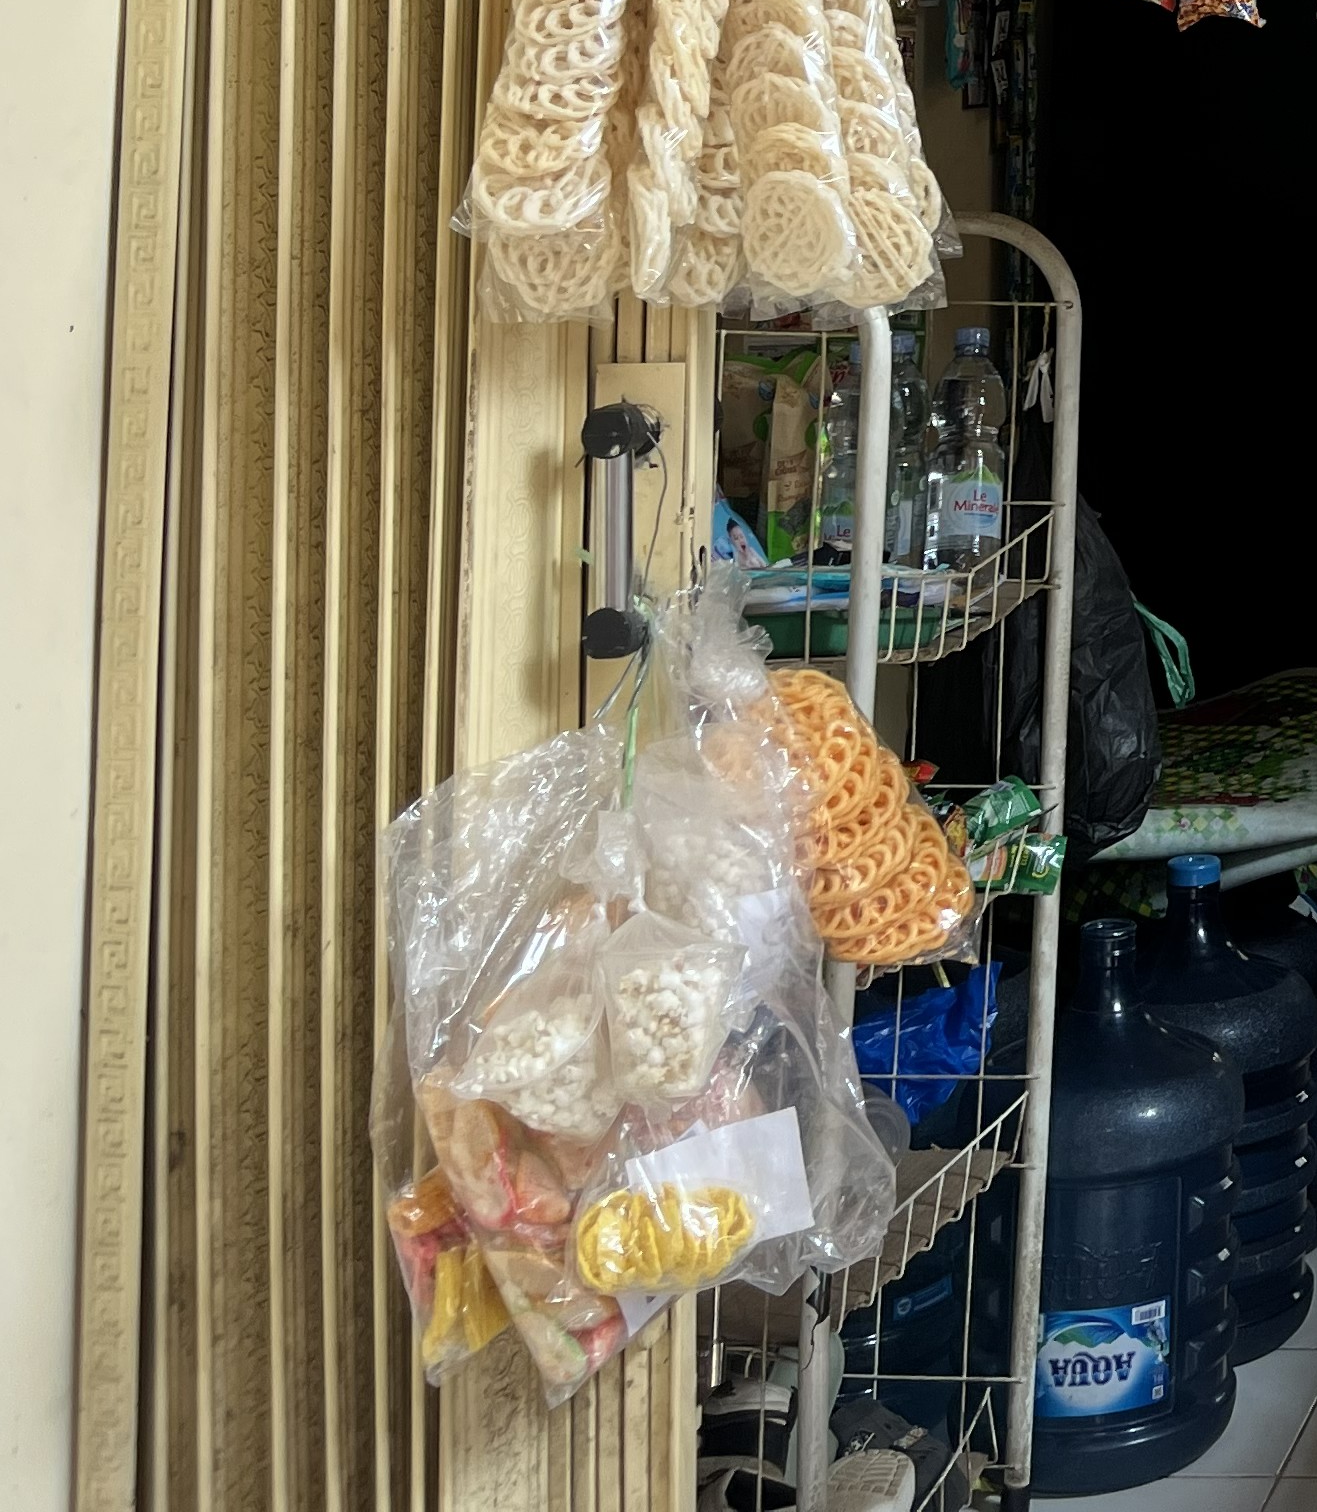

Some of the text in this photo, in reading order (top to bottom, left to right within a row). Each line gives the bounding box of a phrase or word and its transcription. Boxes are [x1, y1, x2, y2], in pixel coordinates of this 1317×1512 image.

[974, 489, 987, 502] Le
[837, 524, 850, 537] Le
[1048, 1351, 1136, 1388] AQUA
